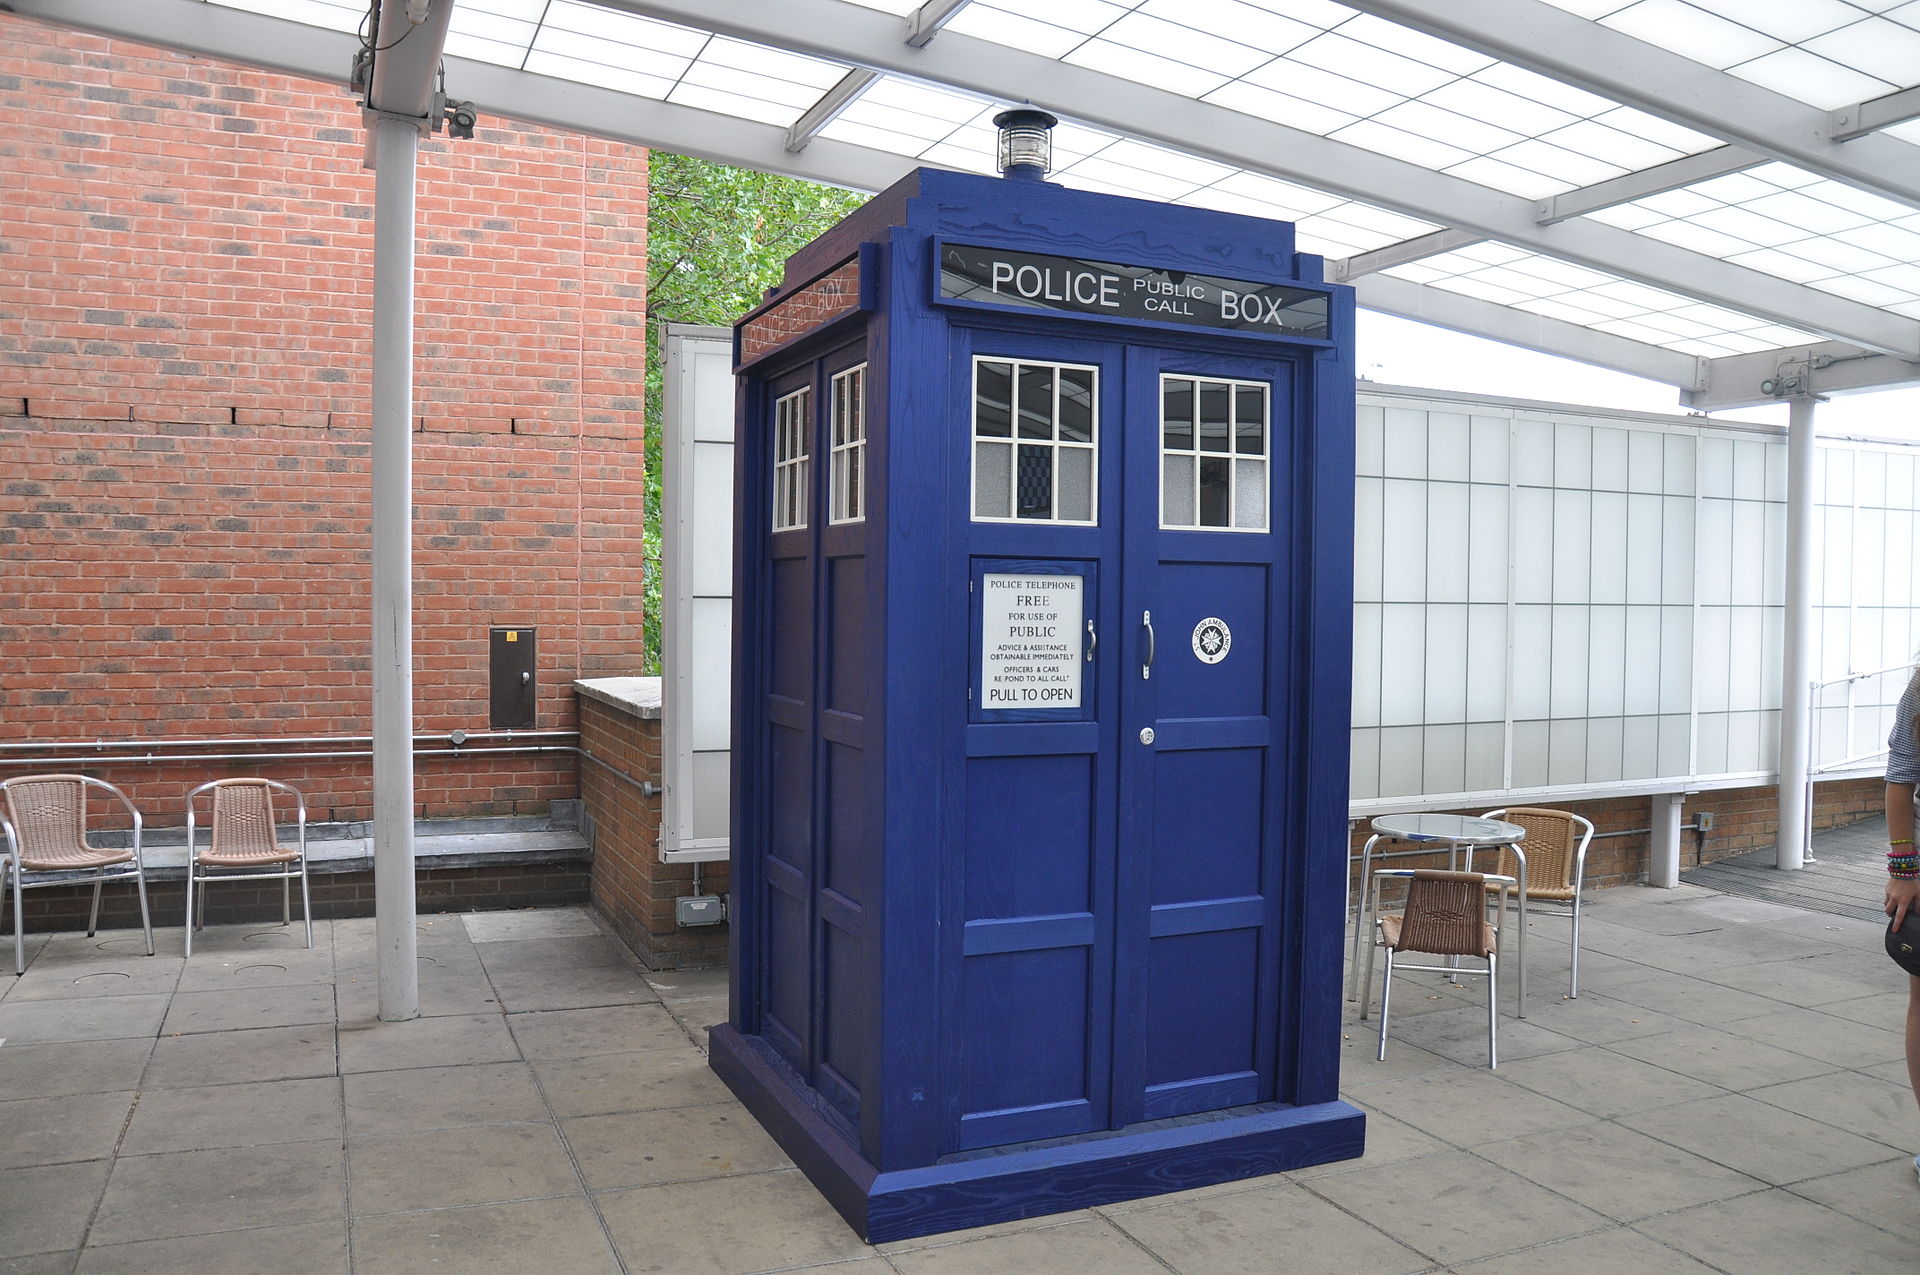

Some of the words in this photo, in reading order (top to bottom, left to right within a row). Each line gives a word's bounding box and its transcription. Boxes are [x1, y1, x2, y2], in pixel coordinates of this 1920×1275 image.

[992, 261, 1120, 307] POLICE
[1133, 278, 1205, 300] PUBLIC
[1221, 290, 1284, 326] BOX
[749, 310, 785, 352] POLICE
[817, 275, 843, 316] BOX
[1144, 297, 1195, 316] CALL
[990, 580, 1022, 589] POLICE
[1025, 581, 1077, 590] TELEPHONE
[1016, 595, 1050, 606] FREE
[1008, 612, 1026, 621] FOR
[1028, 612, 1045, 621] USE
[1046, 613, 1058, 621] OF
[1009, 626, 1056, 638] PUBLIC
[1194, 621, 1206, 640] JOHN
[1208, 619, 1229, 653] AMBULANCE
[990, 688, 1018, 701] PULL
[1021, 688, 1038, 701] TO
[1040, 687, 1073, 701] OPEN
